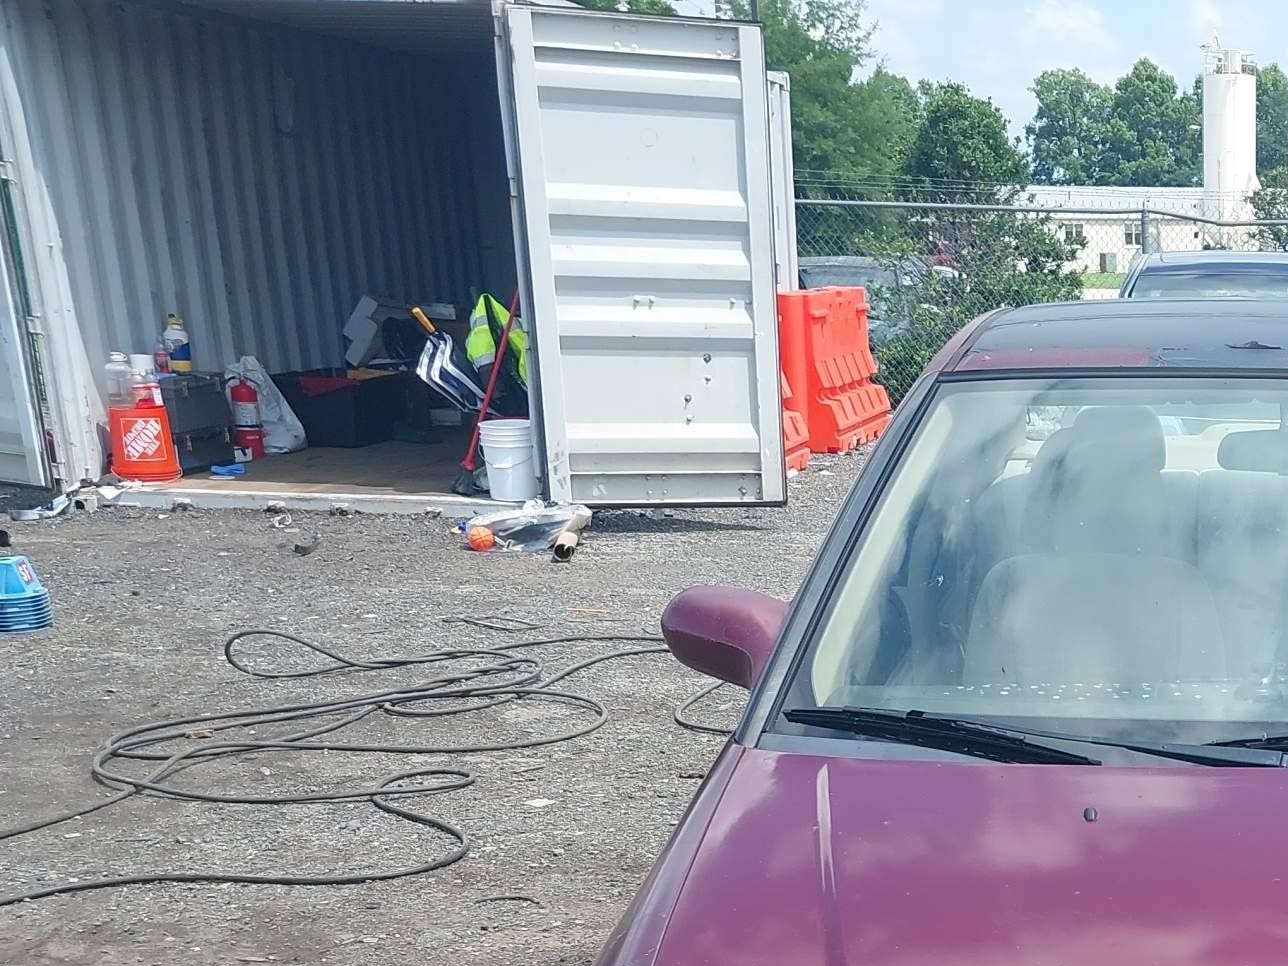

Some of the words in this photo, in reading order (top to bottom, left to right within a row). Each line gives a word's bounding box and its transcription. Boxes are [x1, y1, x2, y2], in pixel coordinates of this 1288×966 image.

[123, 419, 147, 446] DEPOT
[126, 419, 161, 459] HOME
[144, 439, 161, 457] THE
